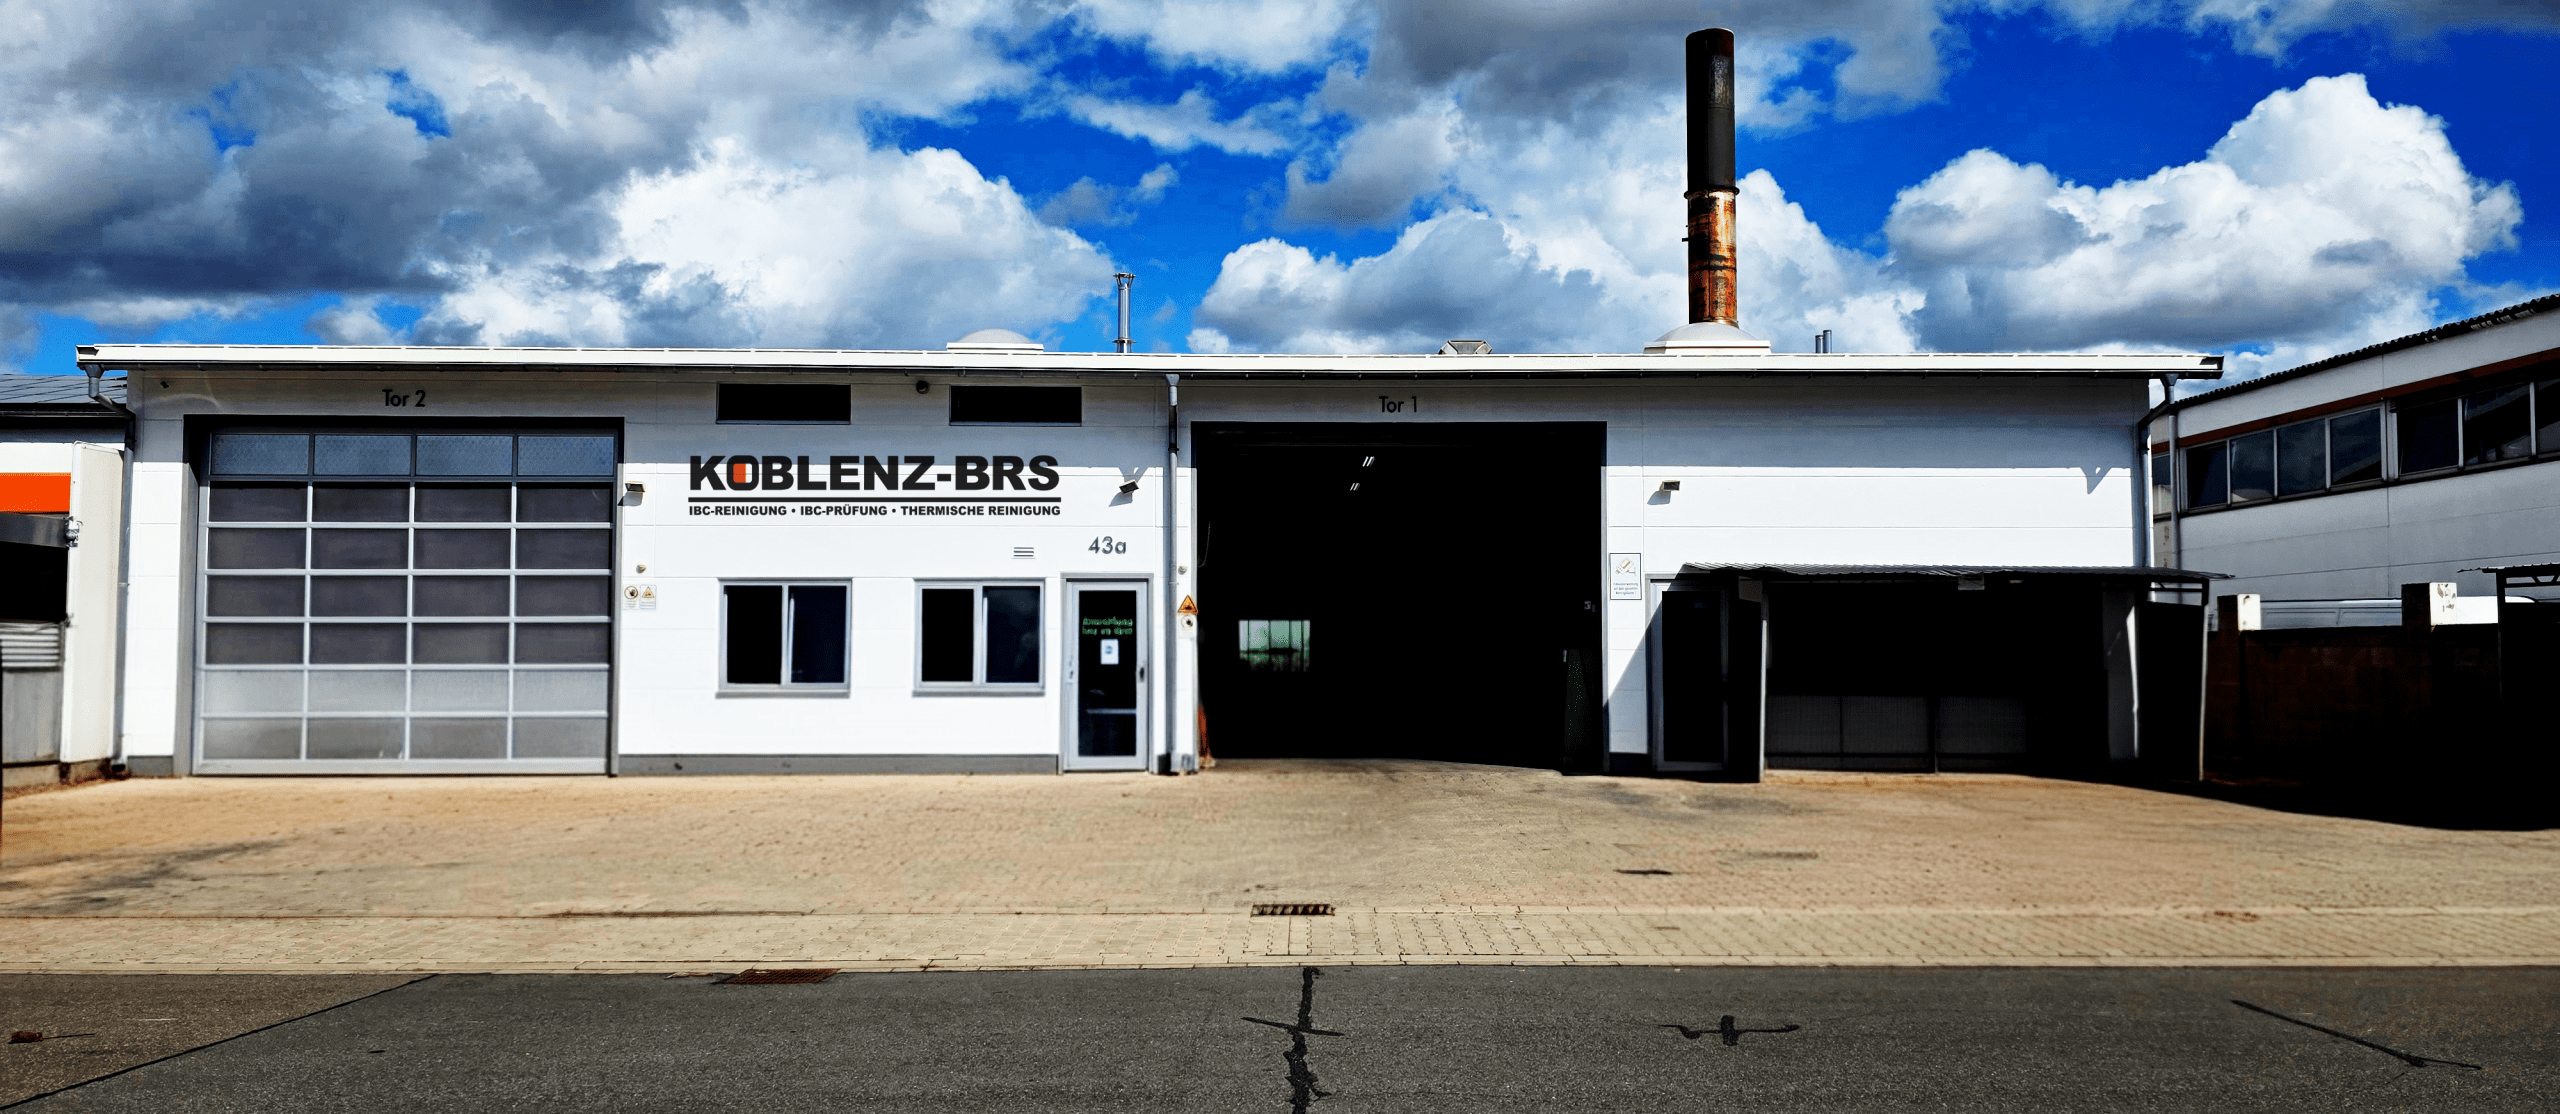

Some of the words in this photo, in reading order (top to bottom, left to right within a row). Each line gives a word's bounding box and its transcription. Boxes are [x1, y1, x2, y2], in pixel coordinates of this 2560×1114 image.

[382, 389, 410, 407] Tor
[415, 389, 426, 407] 2
[1379, 396, 1405, 413] Tor
[1411, 396, 1417, 413] 1
[690, 455, 1060, 491] KOBLENZ-BRS
[689, 506, 787, 516] IBC-REINIGUNG
[800, 504, 888, 516] IBC-PRÜFUNG
[901, 506, 984, 516] THERMISCHE
[988, 506, 1061, 516] REINIGUNG
[1088, 536, 1126, 554] 43a
